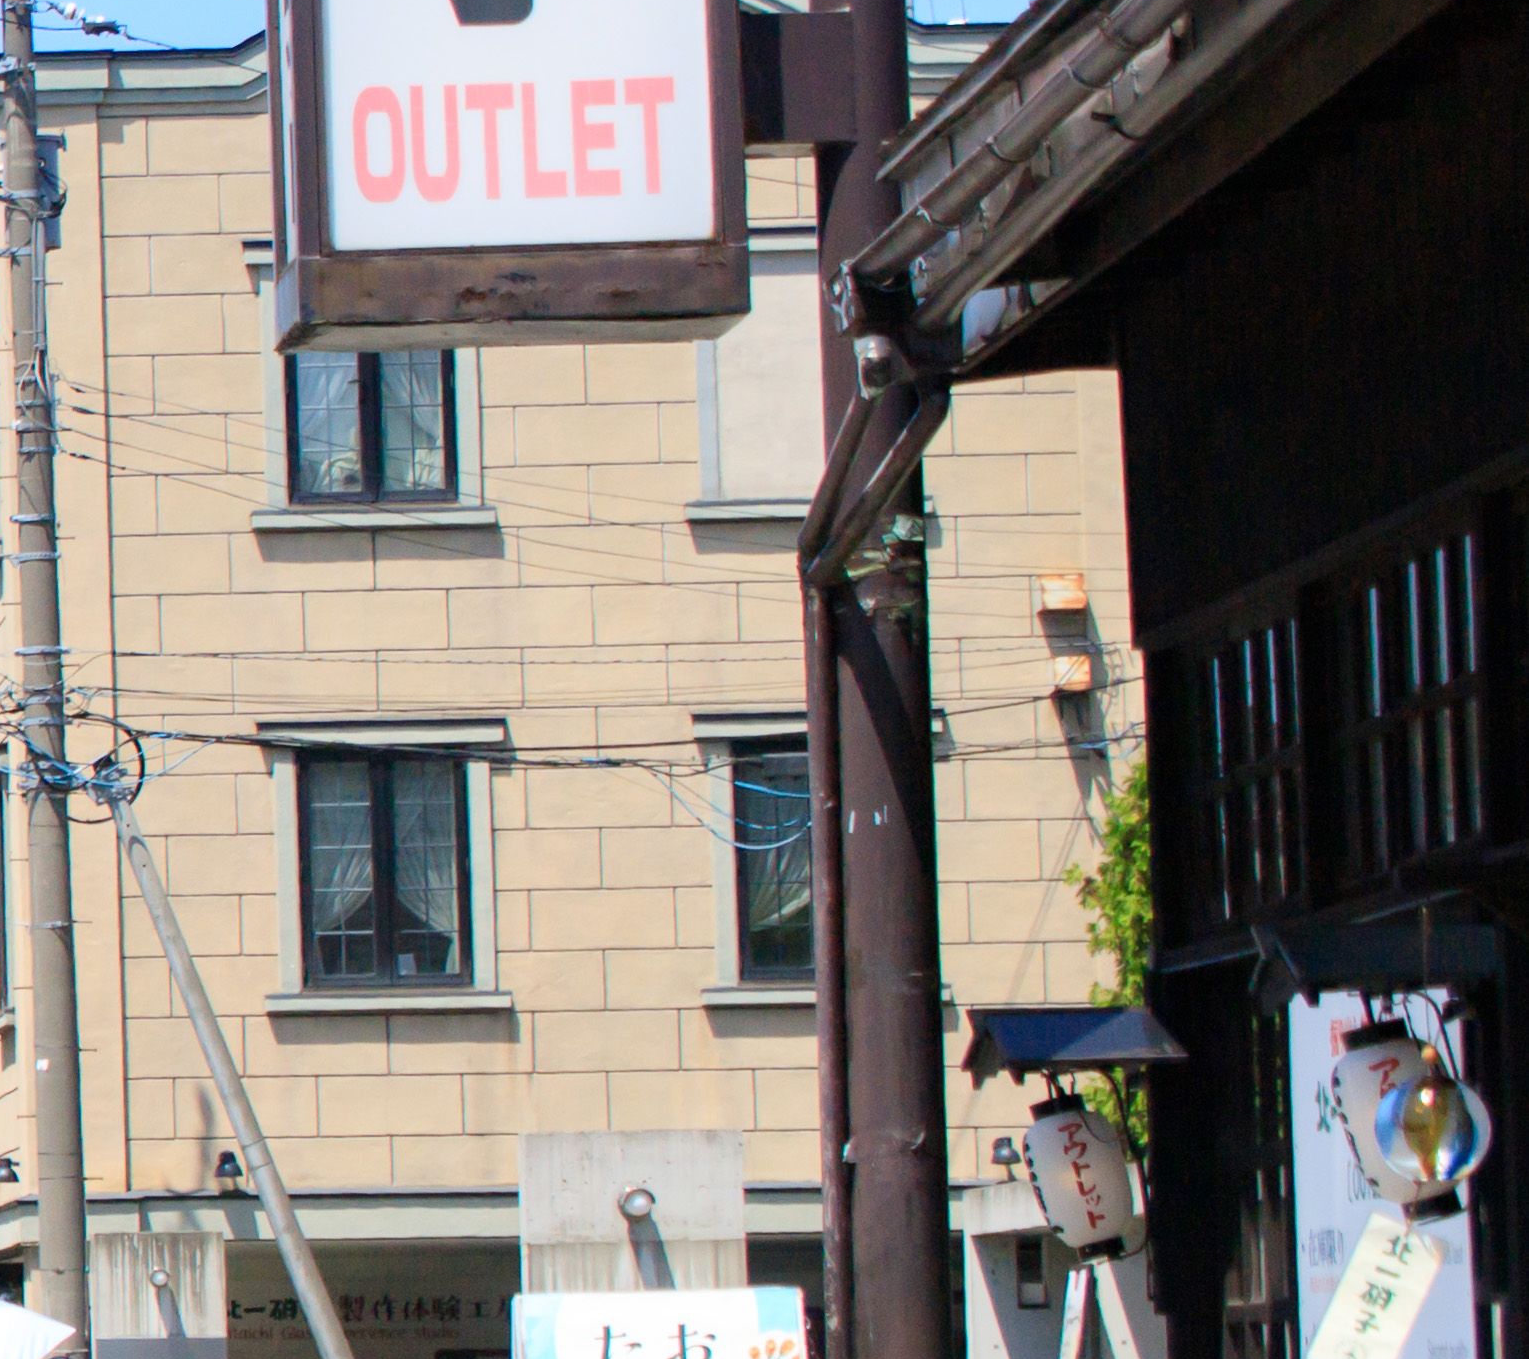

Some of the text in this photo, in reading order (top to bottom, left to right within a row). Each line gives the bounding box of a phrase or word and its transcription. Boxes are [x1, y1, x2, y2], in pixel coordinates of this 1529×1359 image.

[352, 75, 677, 204] OUTLET
[1056, 1120, 1107, 1230] アウトレット
[228, 1297, 299, 1320] 一硝
[1352, 1236, 1413, 1335] 北一硝子
